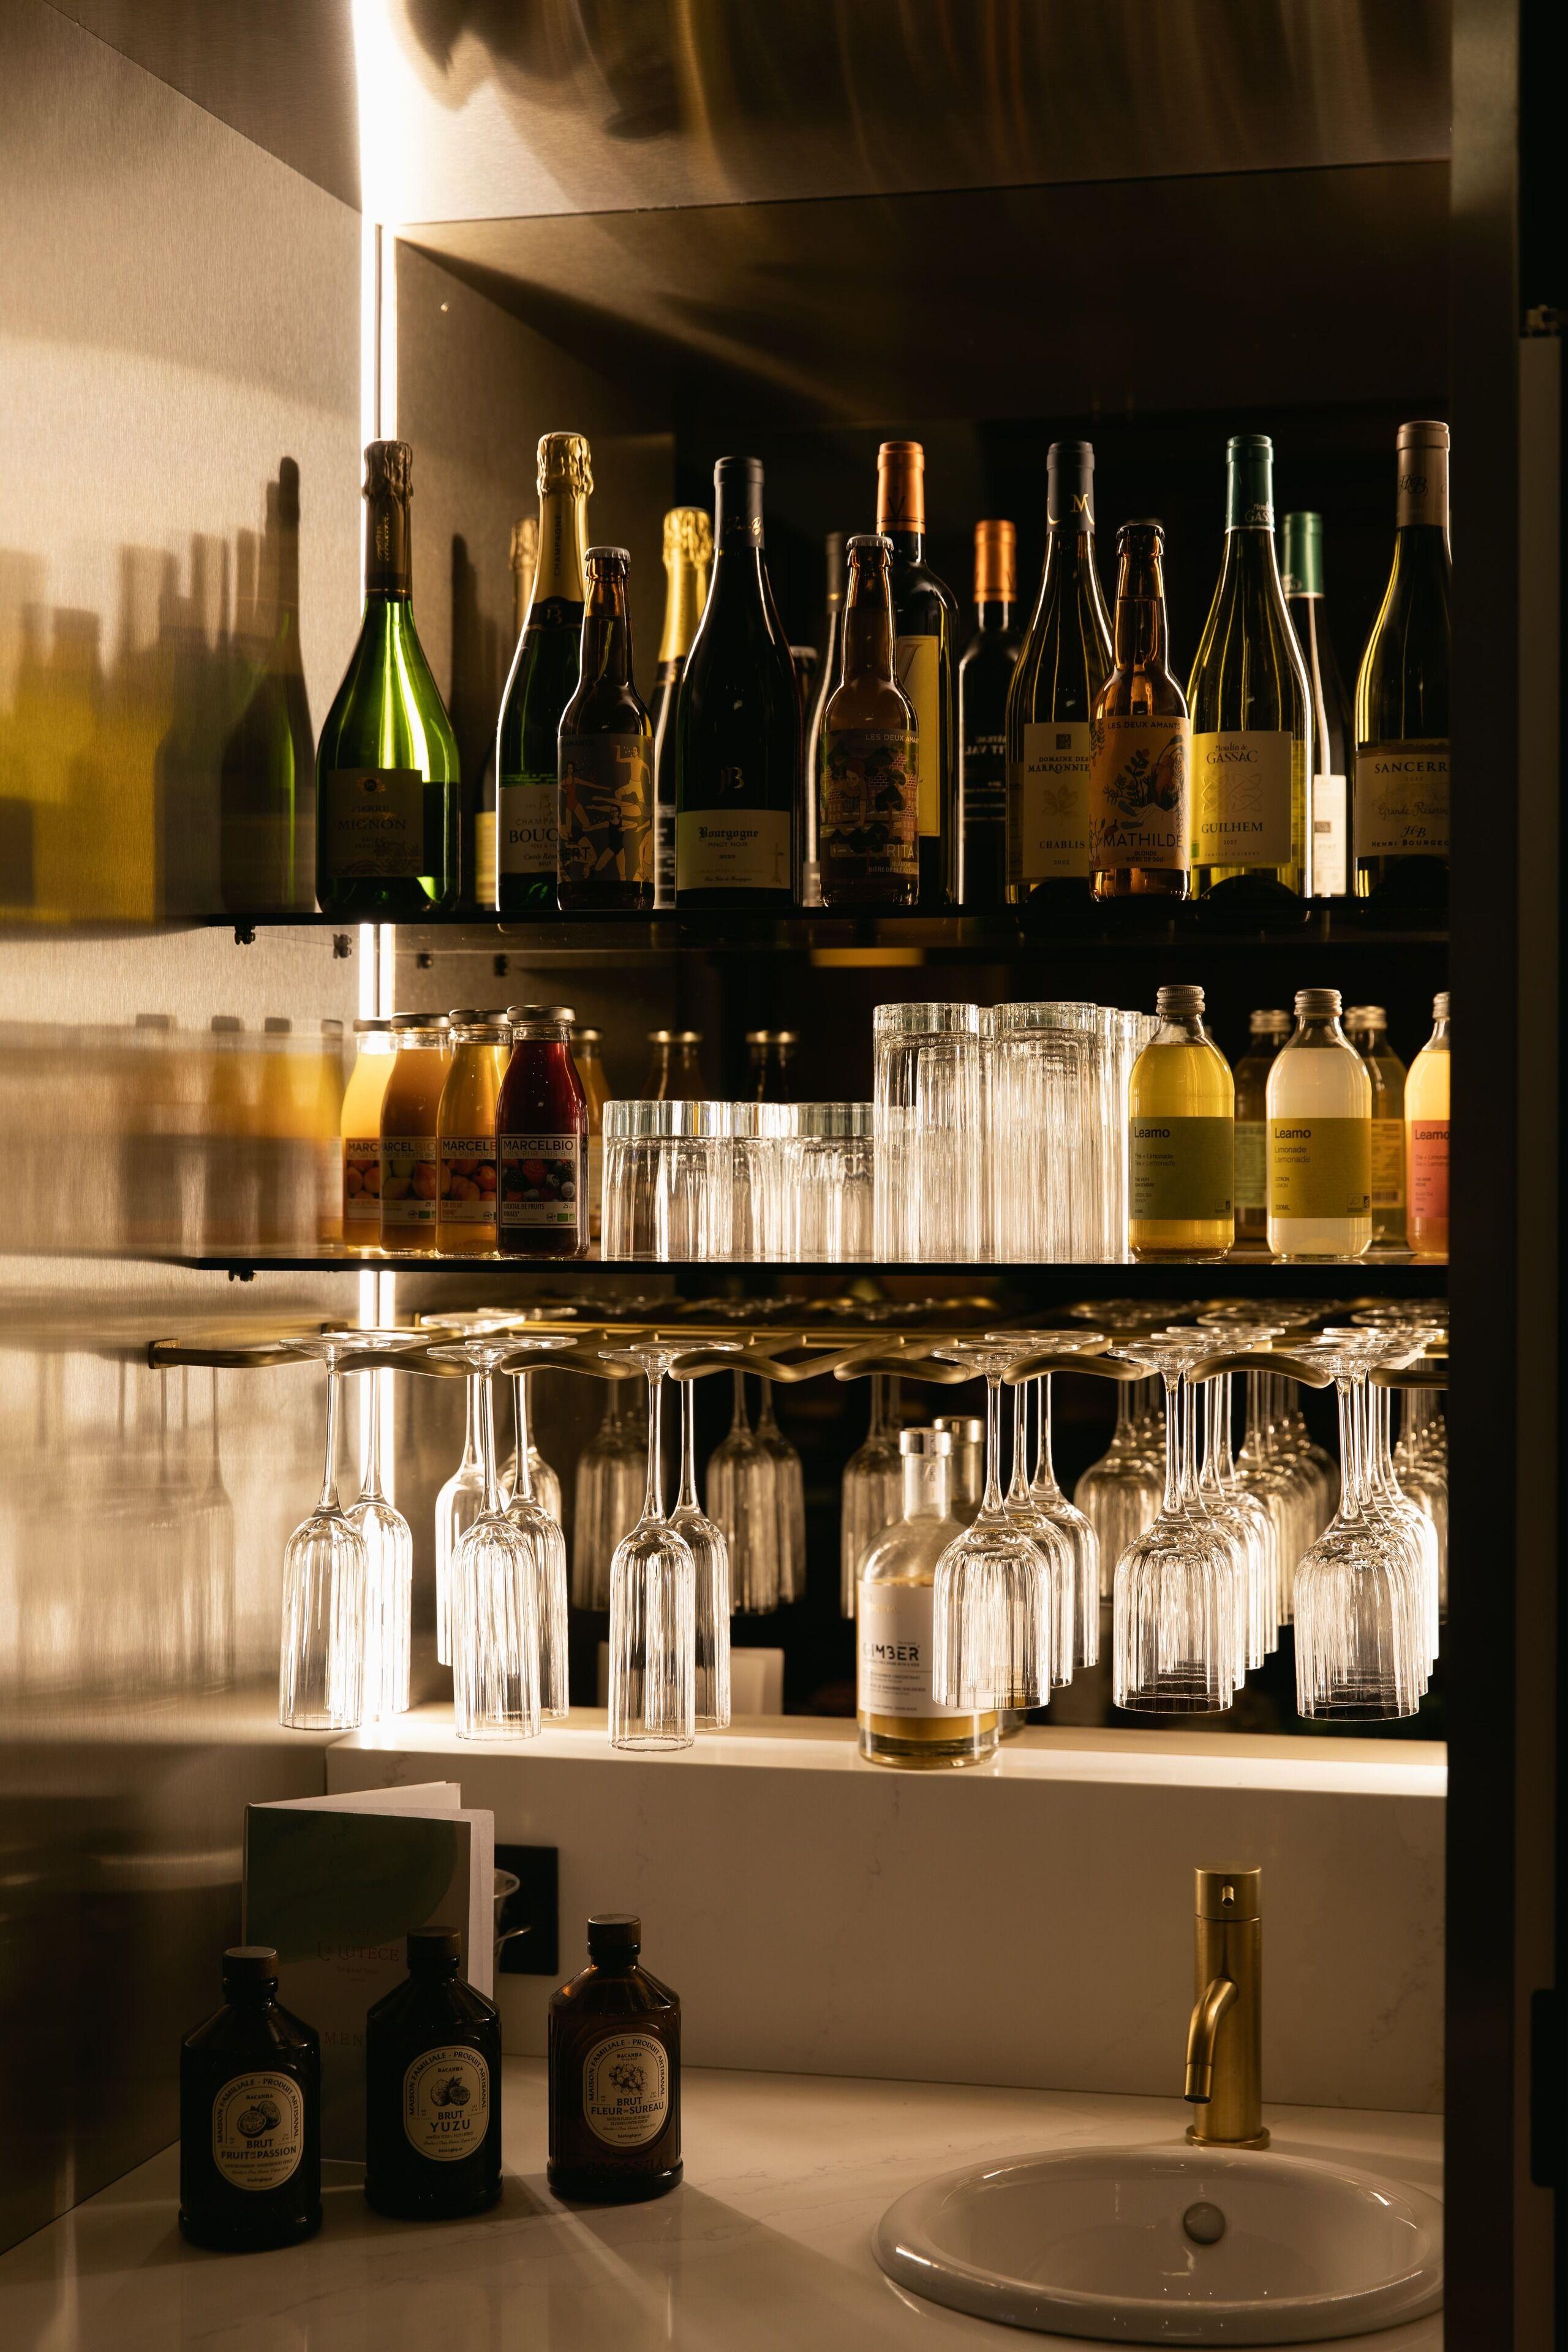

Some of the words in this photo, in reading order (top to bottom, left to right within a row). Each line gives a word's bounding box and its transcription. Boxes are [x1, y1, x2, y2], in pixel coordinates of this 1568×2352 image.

[1215, 741, 1239, 752] Moulin
[1207, 750, 1258, 764] GASSAC
[1374, 761, 1450, 774] SANCERR
[1378, 802, 1411, 821] Grande
[338, 818, 407, 831] MIGNON
[516, 818, 558, 826] CHAMPA
[1202, 822, 1264, 834] GUILHEM
[698, 826, 759, 842] Bourgogne
[1103, 832, 1183, 848] MATHILDE
[886, 843, 914, 859] RITA
[1039, 840, 1085, 850] CHABLIS
[1134, 1126, 1170, 1138] Leamo
[1275, 1128, 1311, 1139] Leamo
[348, 1142, 379, 1152] MARC
[503, 1140, 573, 1151] MARCELBIO
[412, 2052, 446, 2080] FAMILIALE
[454, 2051, 481, 2068] PRODUIT
[592, 2039, 625, 2067] FAMILIALE
[633, 2039, 660, 2054] PRODUIT
[657, 2055, 666, 2097] ARTISANAL
[617, 2097, 643, 2106] BRUT
[221, 2078, 255, 2108] FAMILIALE
[263, 2078, 293, 2095] PRODUIT
[290, 2095, 300, 2139] ARTISANAL
[437, 2110, 464, 2120] BRUT
[591, 2106, 623, 2116] FLEUR
[630, 2101, 665, 2114] SUREAU
[429, 2119, 470, 2133] YUZU
[246, 2138, 274, 2149] BRUT
[221, 2150, 250, 2160] FRUIT
[257, 2145, 296, 2159] PASSION
